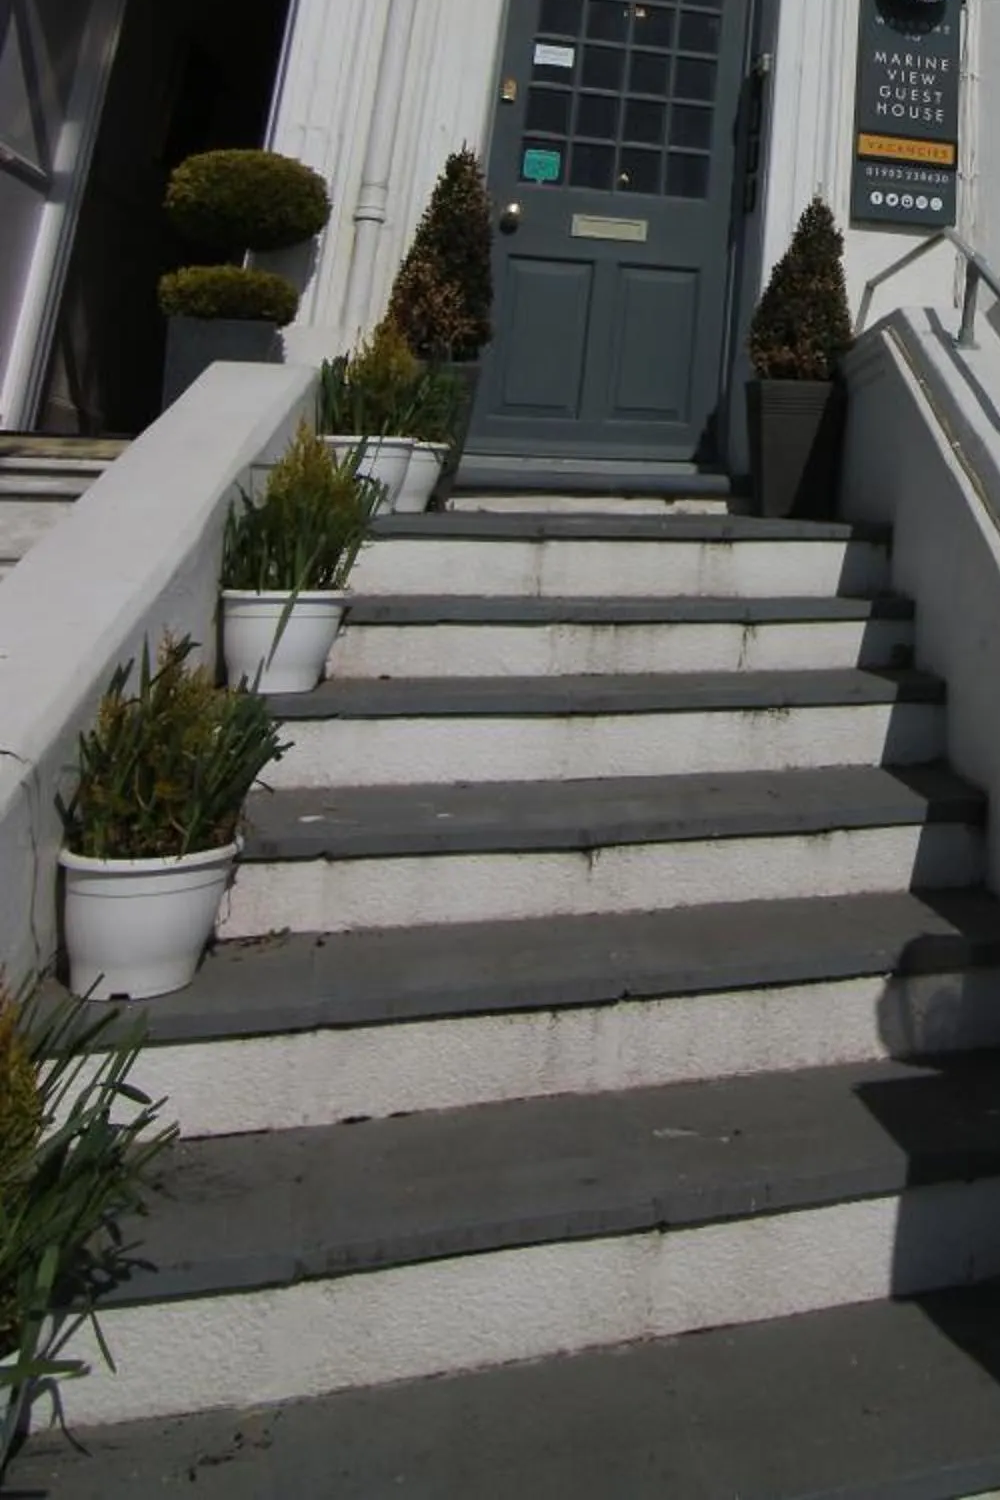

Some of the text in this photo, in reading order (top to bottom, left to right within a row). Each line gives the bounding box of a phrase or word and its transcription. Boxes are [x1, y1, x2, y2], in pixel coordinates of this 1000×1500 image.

[874, 51, 949, 71] MARINE
[887, 68, 935, 85] VIEW
[879, 85, 943, 103] GUEST
[876, 101, 944, 122] HOUSE
